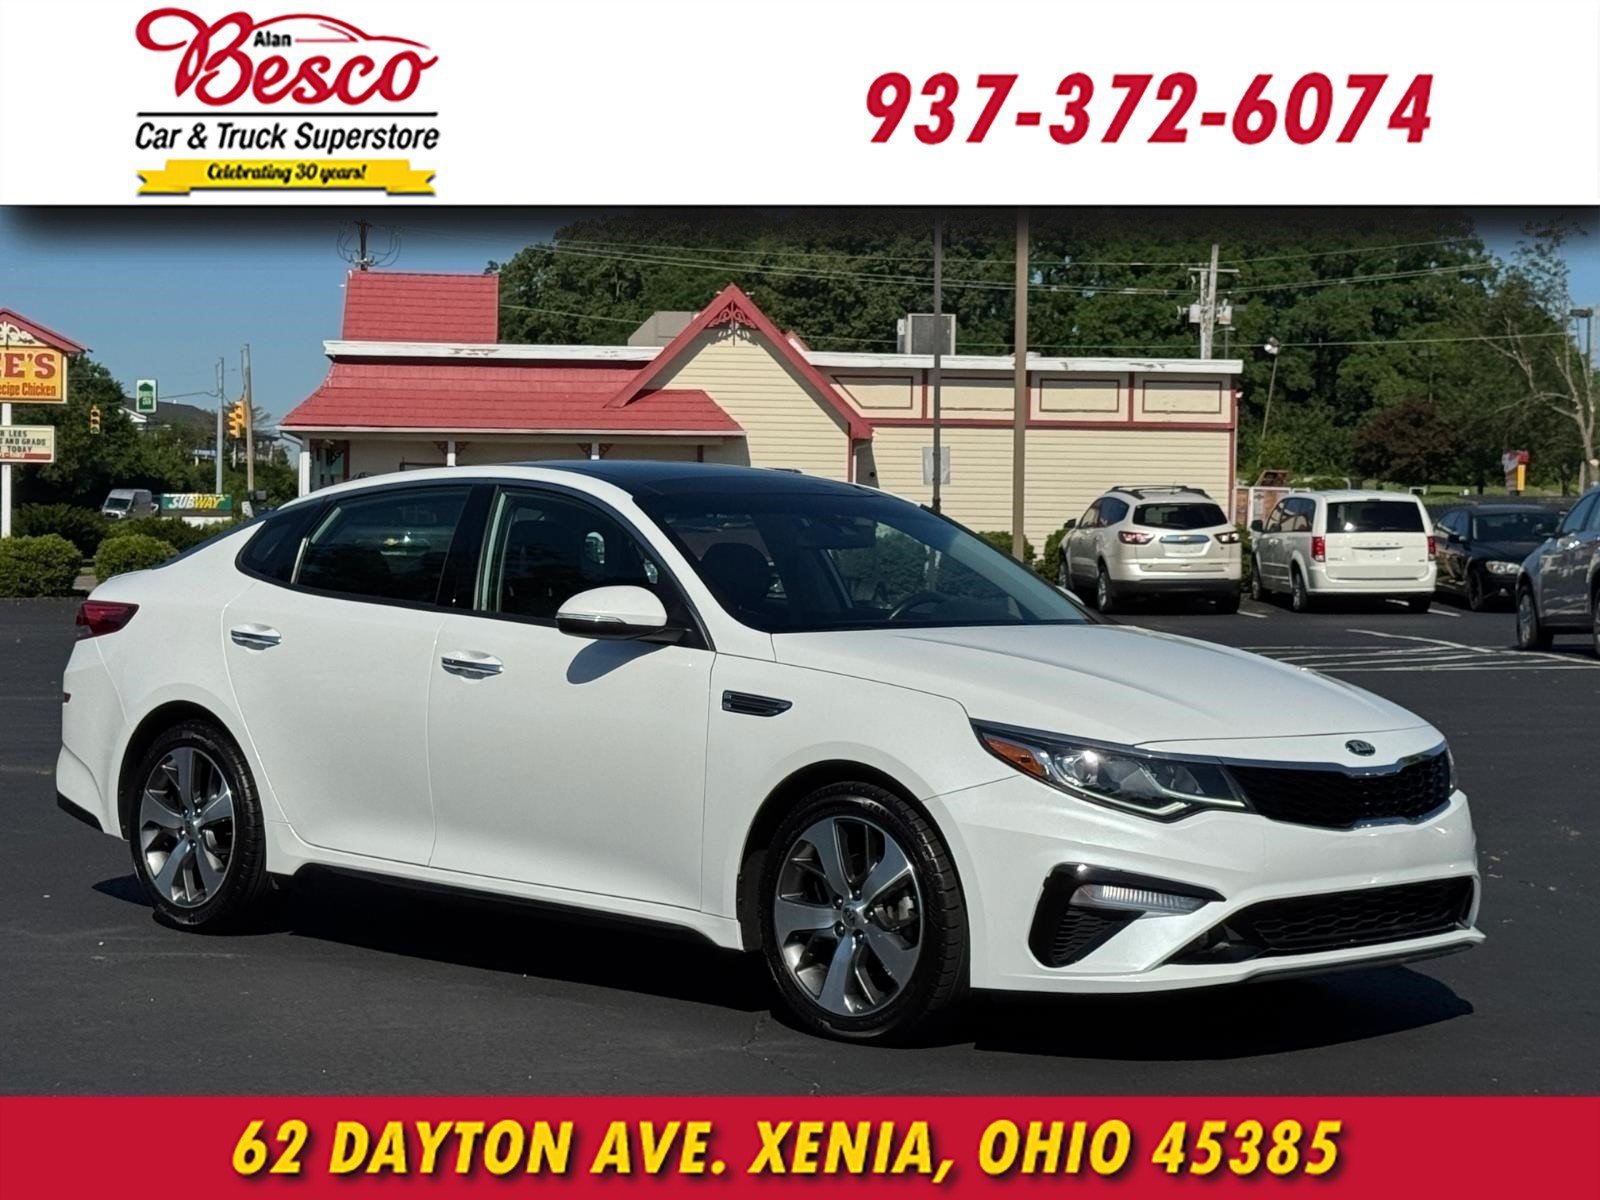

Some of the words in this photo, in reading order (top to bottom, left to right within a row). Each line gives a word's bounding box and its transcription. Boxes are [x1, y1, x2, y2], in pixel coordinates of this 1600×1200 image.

[0, 353, 56, 379] E'S
[22, 382, 56, 397] Chicken
[9, 430, 27, 438] LEES
[7, 445, 32, 453] TODAY
[168, 494, 225, 509] SUBWAY
